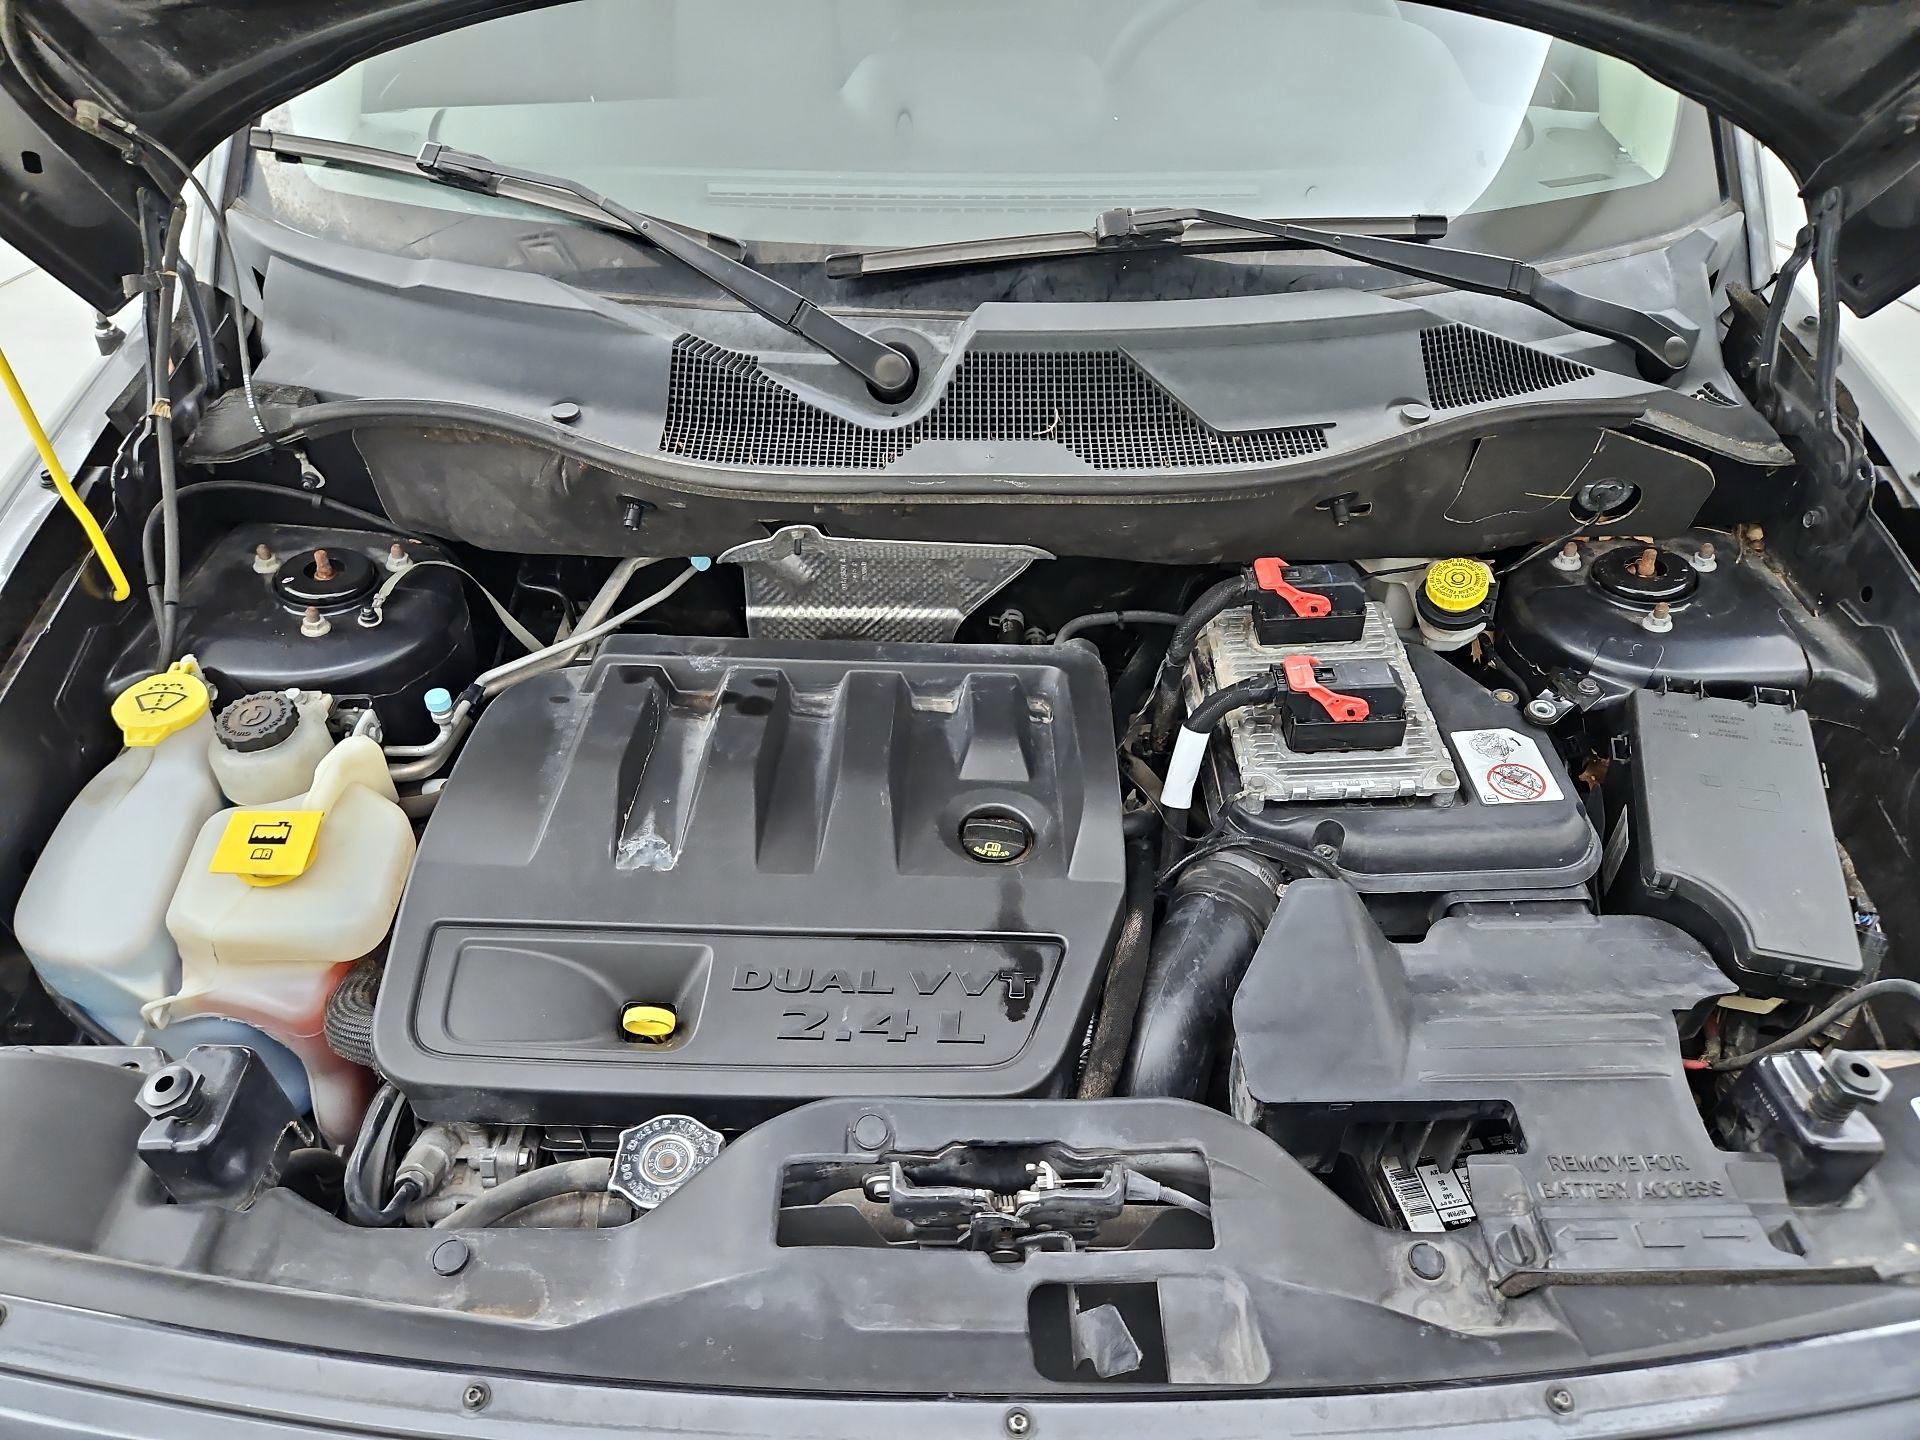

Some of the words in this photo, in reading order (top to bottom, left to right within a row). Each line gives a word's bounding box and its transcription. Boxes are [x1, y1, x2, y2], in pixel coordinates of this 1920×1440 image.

[732, 967, 895, 993] DUAL
[908, 967, 1037, 998] VVT
[620, 1153, 640, 1163] TVS
[1546, 1153, 1641, 1173] REMOVE
[1640, 1153, 1691, 1173] FOR
[1537, 1180, 1632, 1200] BATTERY
[1637, 1179, 1725, 1199] ACCESS
